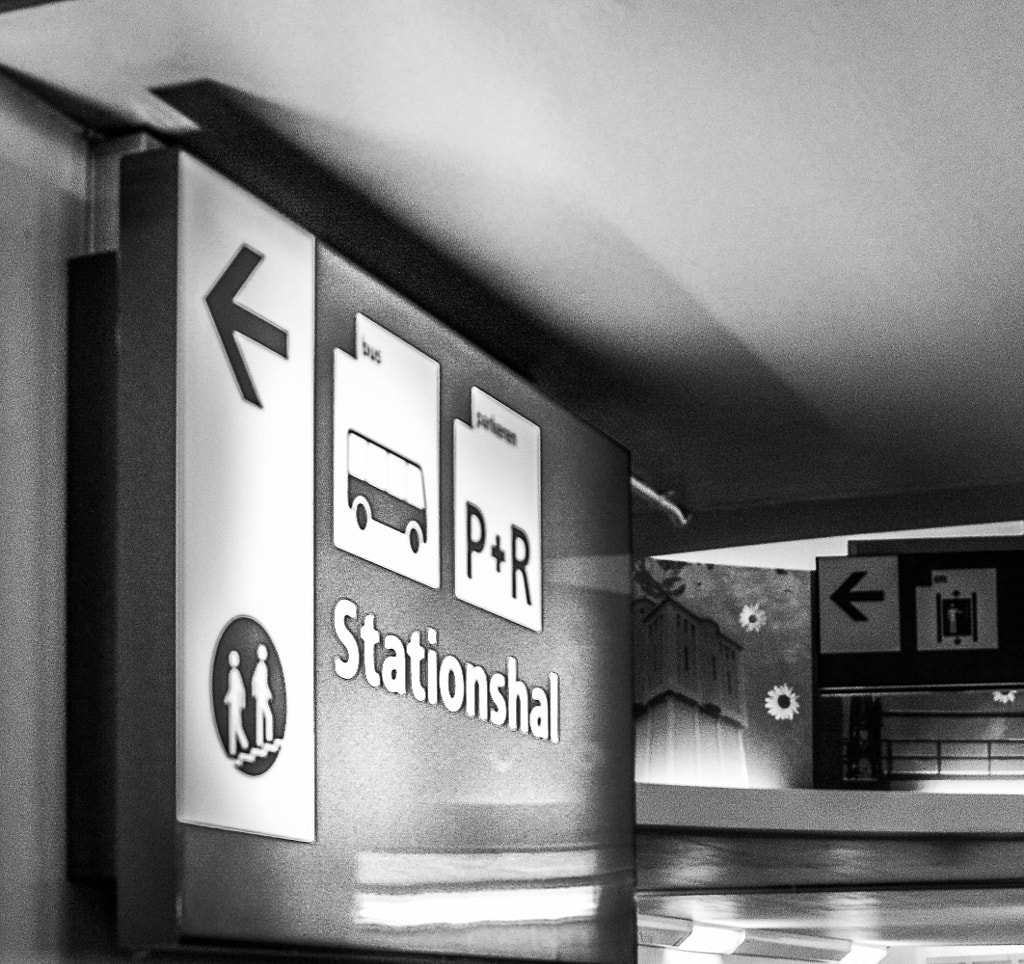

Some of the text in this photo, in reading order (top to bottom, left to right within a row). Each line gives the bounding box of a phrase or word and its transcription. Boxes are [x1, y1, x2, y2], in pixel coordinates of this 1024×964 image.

[362, 338, 381, 364] bus
[466, 501, 532, 605] P+R
[334, 599, 559, 743] Stationshal
